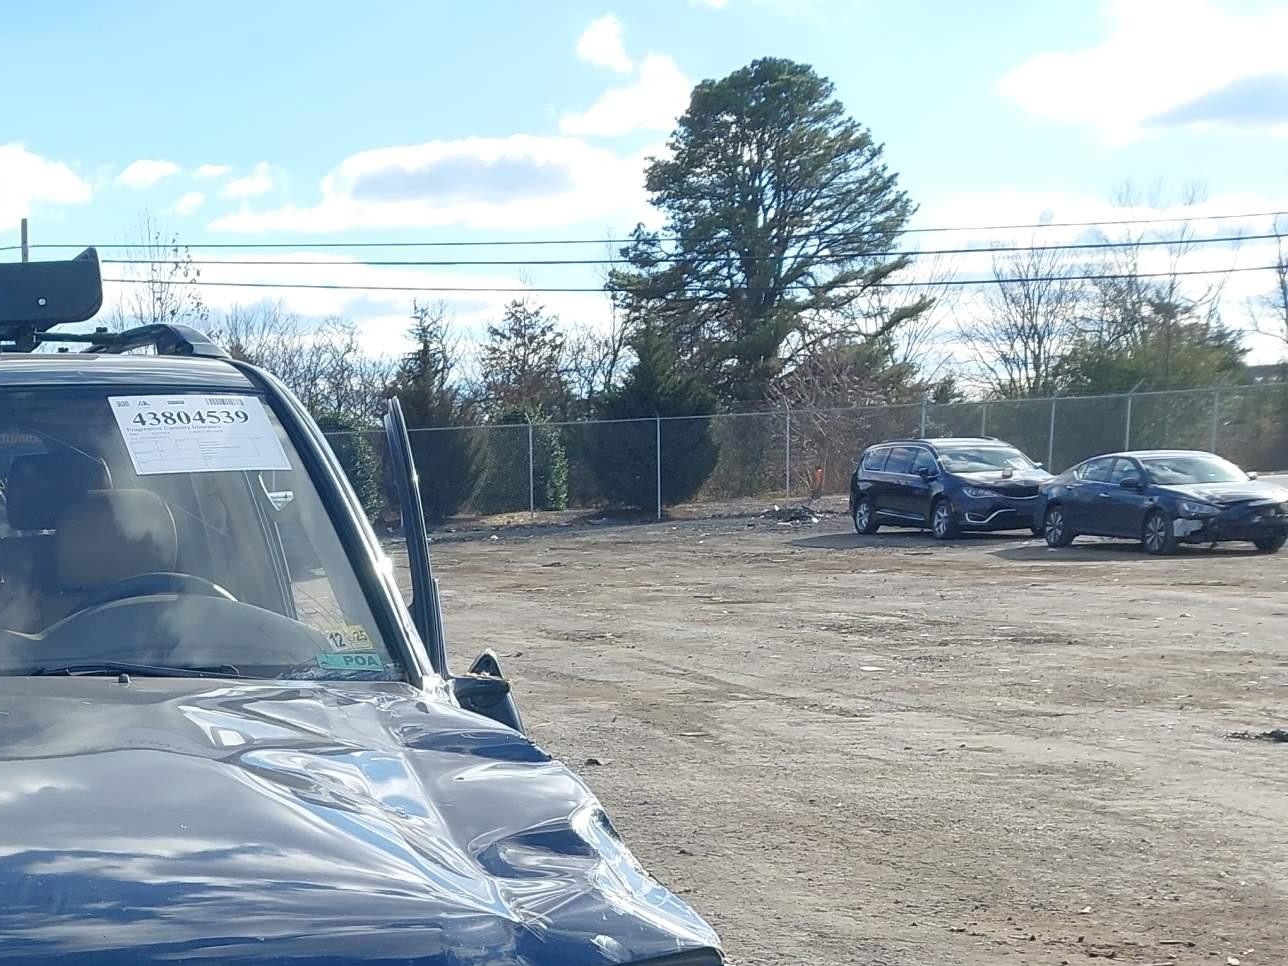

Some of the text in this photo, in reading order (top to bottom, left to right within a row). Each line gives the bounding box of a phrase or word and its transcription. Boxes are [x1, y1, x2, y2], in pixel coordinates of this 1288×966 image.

[133, 410, 249, 426] 43804539
[329, 631, 368, 647] 12 25
[343, 656, 379, 665] POA
